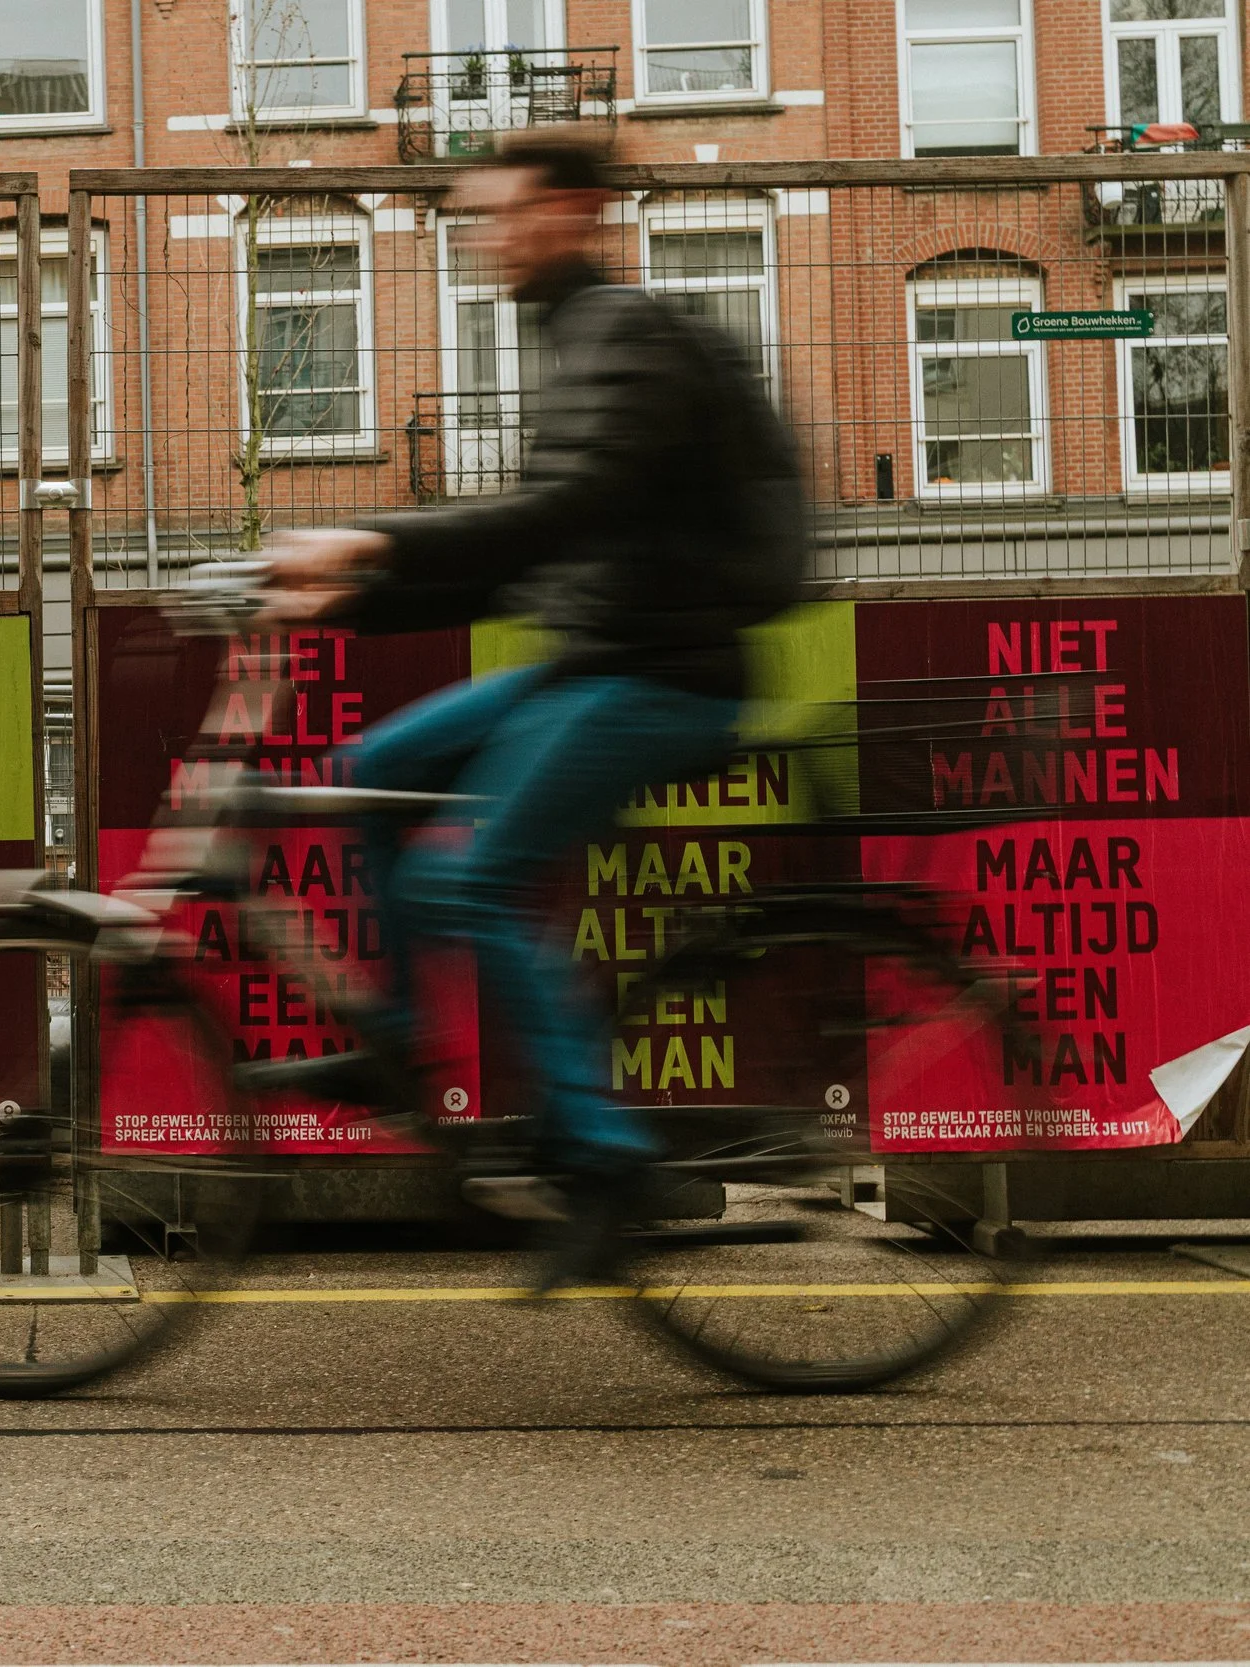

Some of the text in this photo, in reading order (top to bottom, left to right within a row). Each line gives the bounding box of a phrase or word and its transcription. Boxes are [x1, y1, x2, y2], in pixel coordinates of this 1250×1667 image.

[1032, 317, 1069, 327] Groene
[229, 629, 357, 681] NIET
[988, 620, 1118, 675] NIET
[218, 692, 363, 745] ALLE
[981, 684, 1127, 739] ALLE
[933, 748, 1180, 806] MANNEN
[256, 844, 375, 897] AAR
[587, 841, 754, 896] MAAR
[976, 837, 1143, 892] MAAR
[960, 901, 1159, 957] ALTIJD
[1007, 967, 1118, 1022] EEN
[611, 1035, 735, 1090] MAN
[1002, 1032, 1127, 1086] MAN
[115, 1114, 321, 1128] STOP GEWELD TEGEN VROUWEN.
[115, 1127, 371, 1142] SPREEK ELKAAR AAN EN SPREEK JE UIT!
[820, 1113, 857, 1125] OXFAM
[823, 1127, 853, 1138] Novib
[883, 1109, 1095, 1126] STOP GEWELD TEGEN VROUWEN.
[883, 1121, 1149, 1139] SPREEK ELKAAR AAN EN SPREEK JE UIT!
